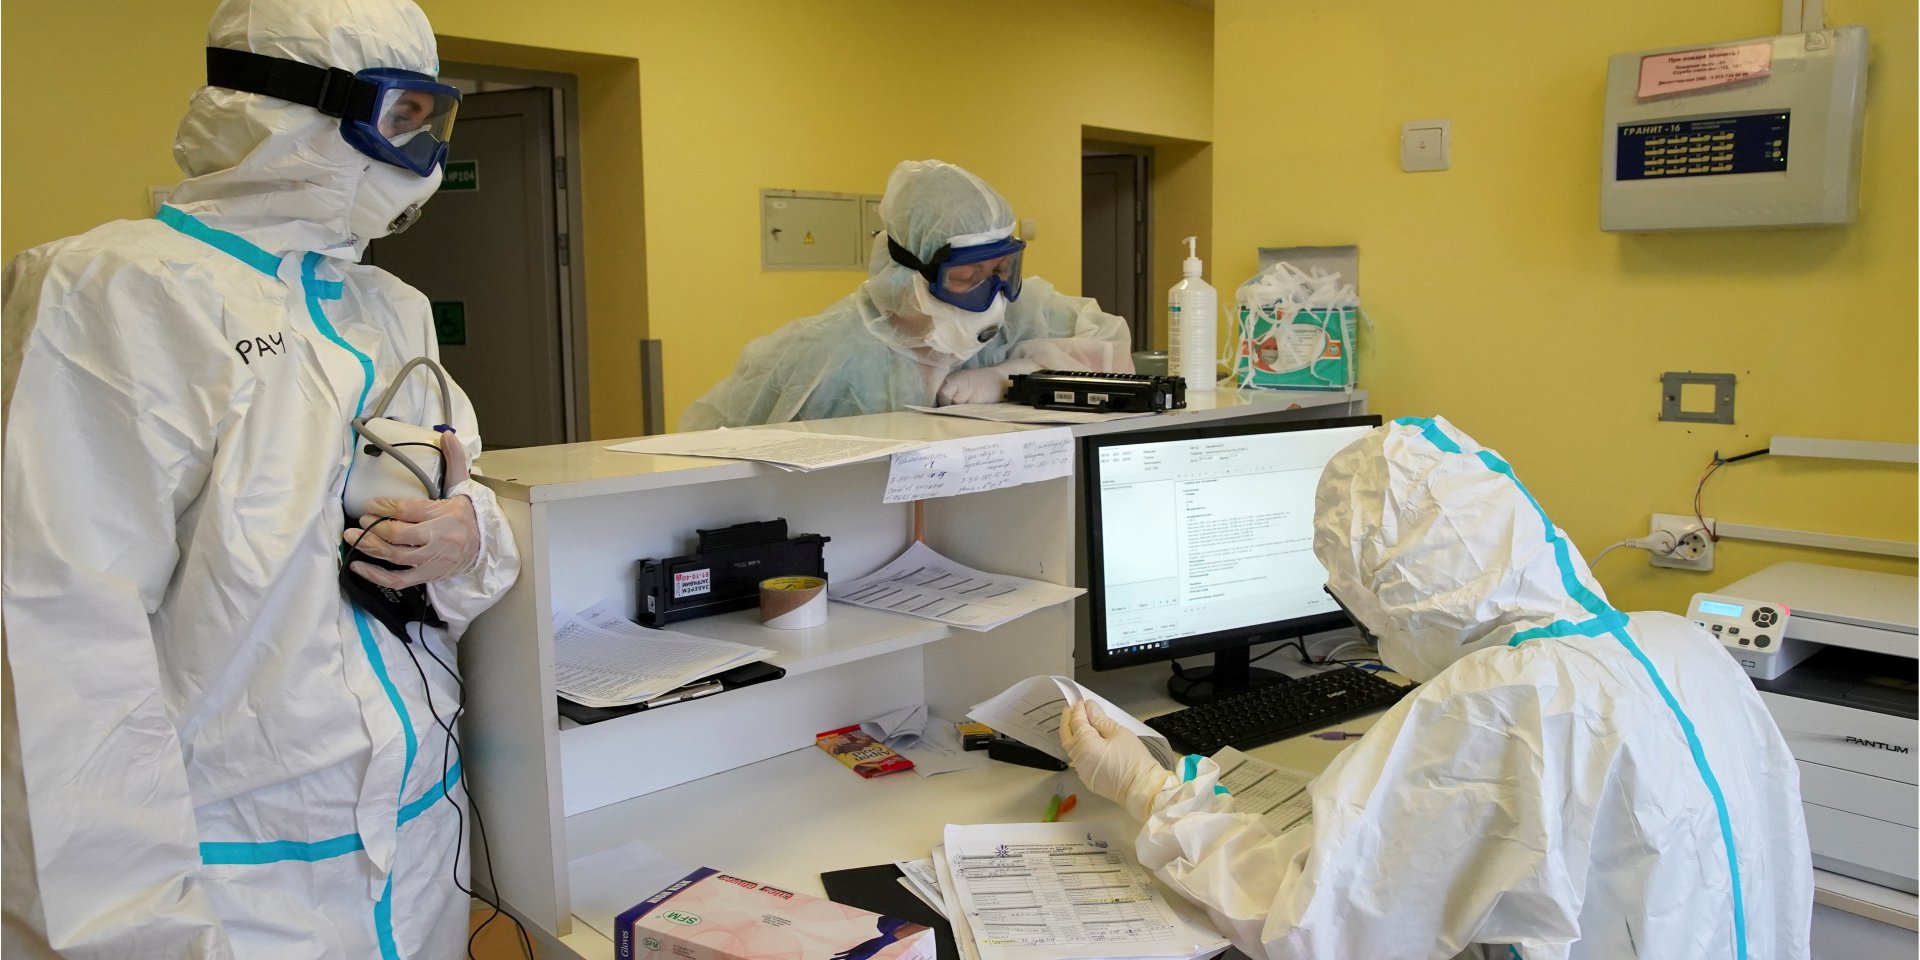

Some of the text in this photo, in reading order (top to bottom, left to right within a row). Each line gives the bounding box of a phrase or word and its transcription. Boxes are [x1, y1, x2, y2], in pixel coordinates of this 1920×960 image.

[1623, 125, 1663, 136] ГРАНИТ
[1671, 124, 1681, 133] 16
[1846, 735, 1909, 755] PANTUM
[667, 912, 698, 924] SFM
[620, 930, 629, 958] Gloves
[644, 939, 659, 949] SFM
